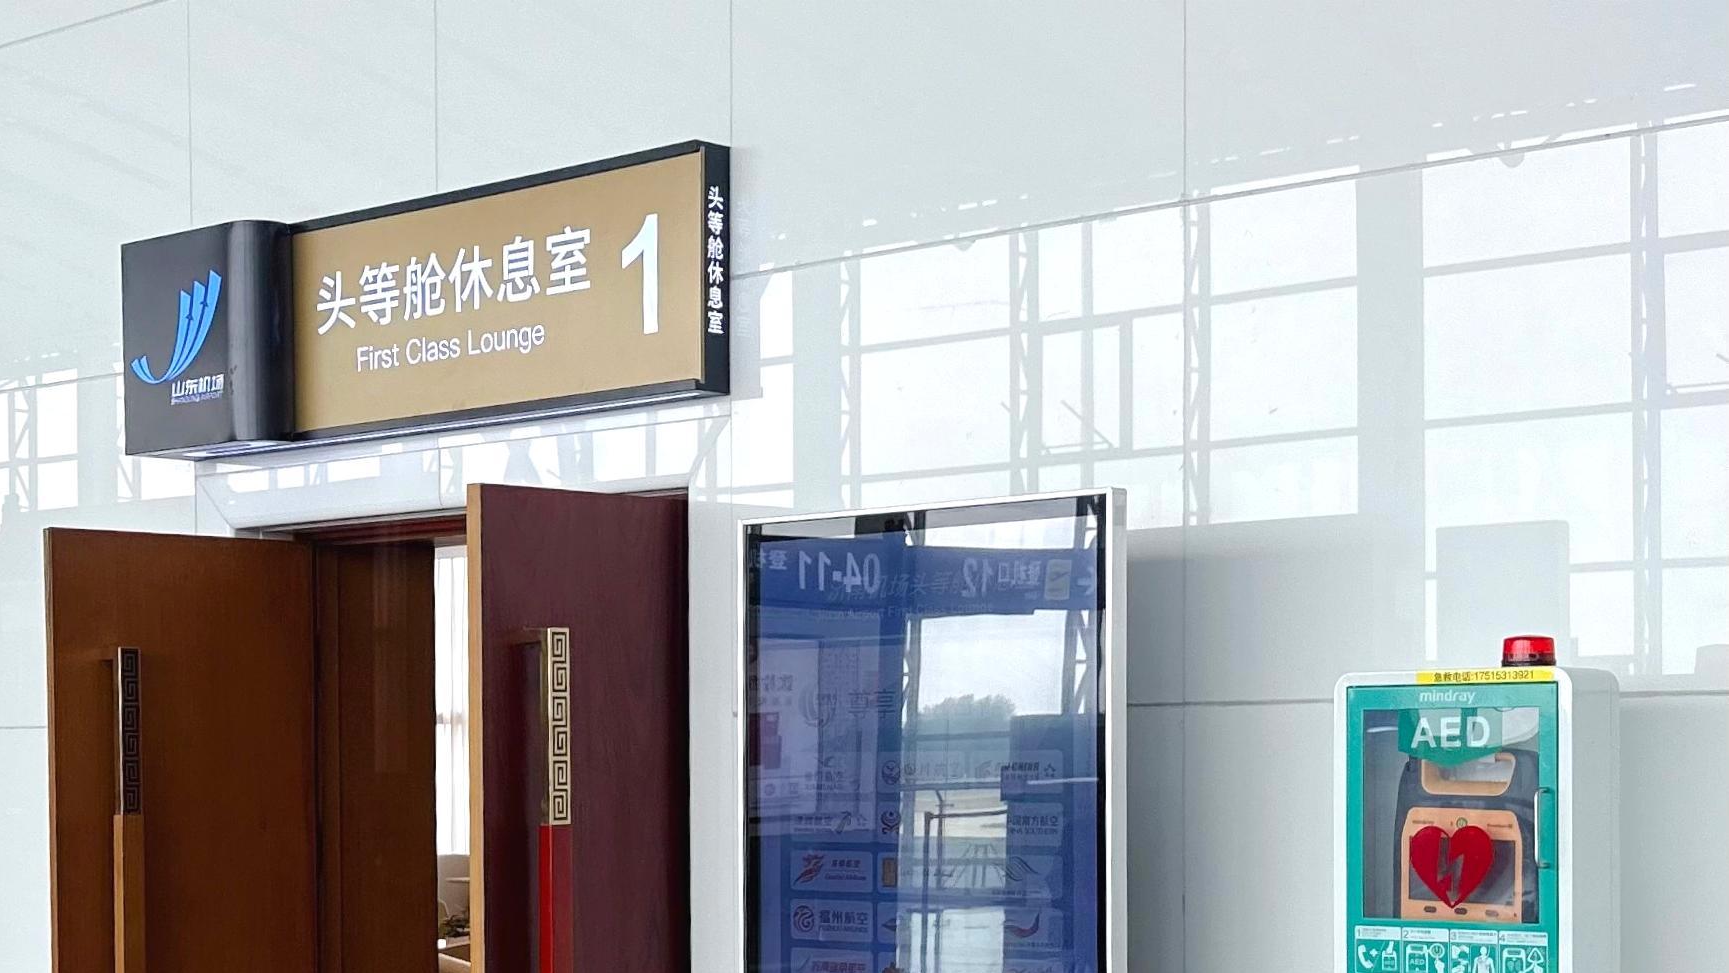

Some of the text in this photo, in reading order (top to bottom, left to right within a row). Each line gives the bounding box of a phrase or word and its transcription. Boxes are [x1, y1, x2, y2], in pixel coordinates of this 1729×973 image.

[316, 212, 659, 335] 头等舱休息室 1
[706, 186, 724, 335] 头等舱休息室
[357, 323, 546, 372] First Class Lounge
[171, 374, 225, 398] 山东机场
[1420, 689, 1475, 705] mindray
[1411, 716, 1491, 749] AED
